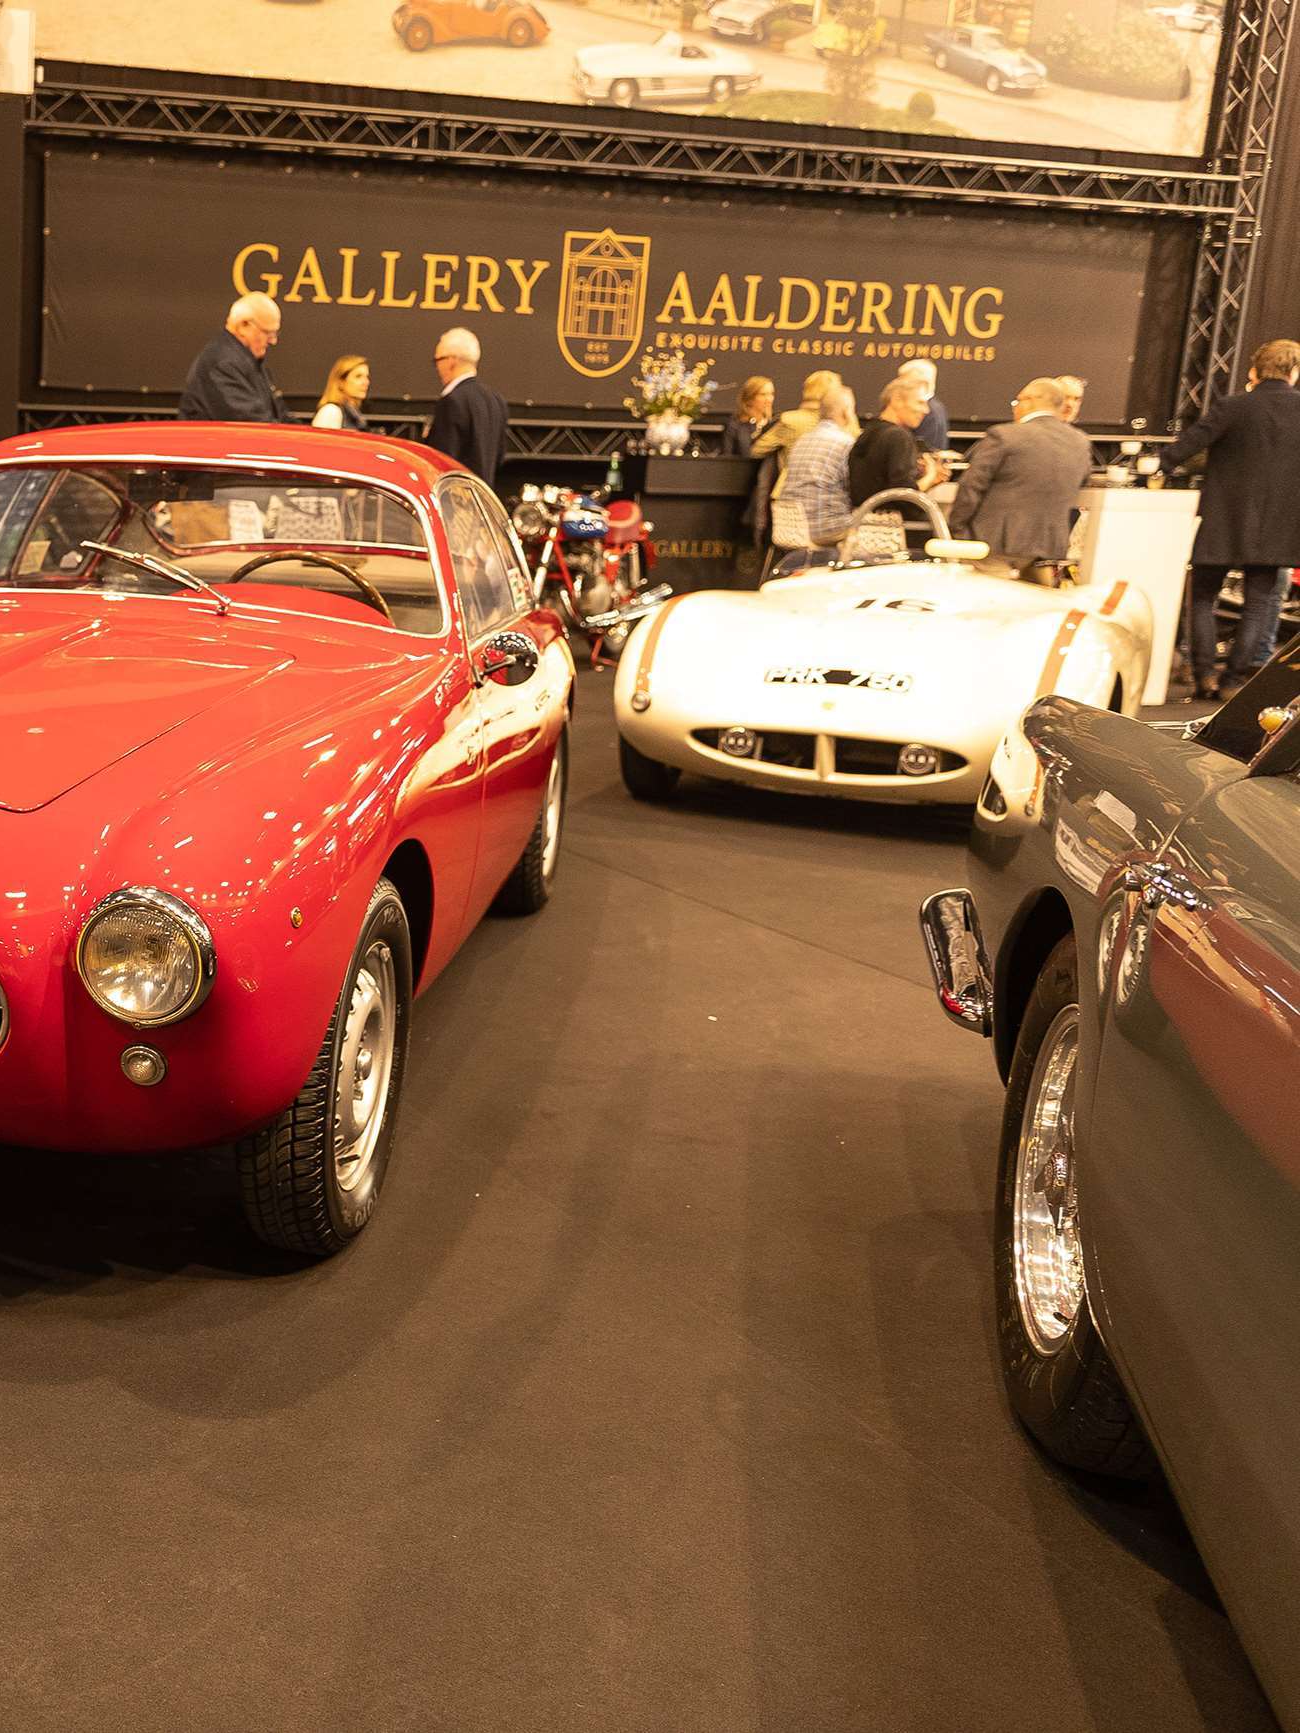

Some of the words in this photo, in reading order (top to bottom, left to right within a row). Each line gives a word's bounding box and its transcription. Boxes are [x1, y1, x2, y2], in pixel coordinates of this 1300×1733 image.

[232, 243, 550, 315] GALLERY
[655, 270, 1004, 339] AALDERING
[655, 331, 764, 353] EXQUISITE
[771, 337, 855, 357] CLASSIC
[863, 341, 997, 362] AUTOMOBILES
